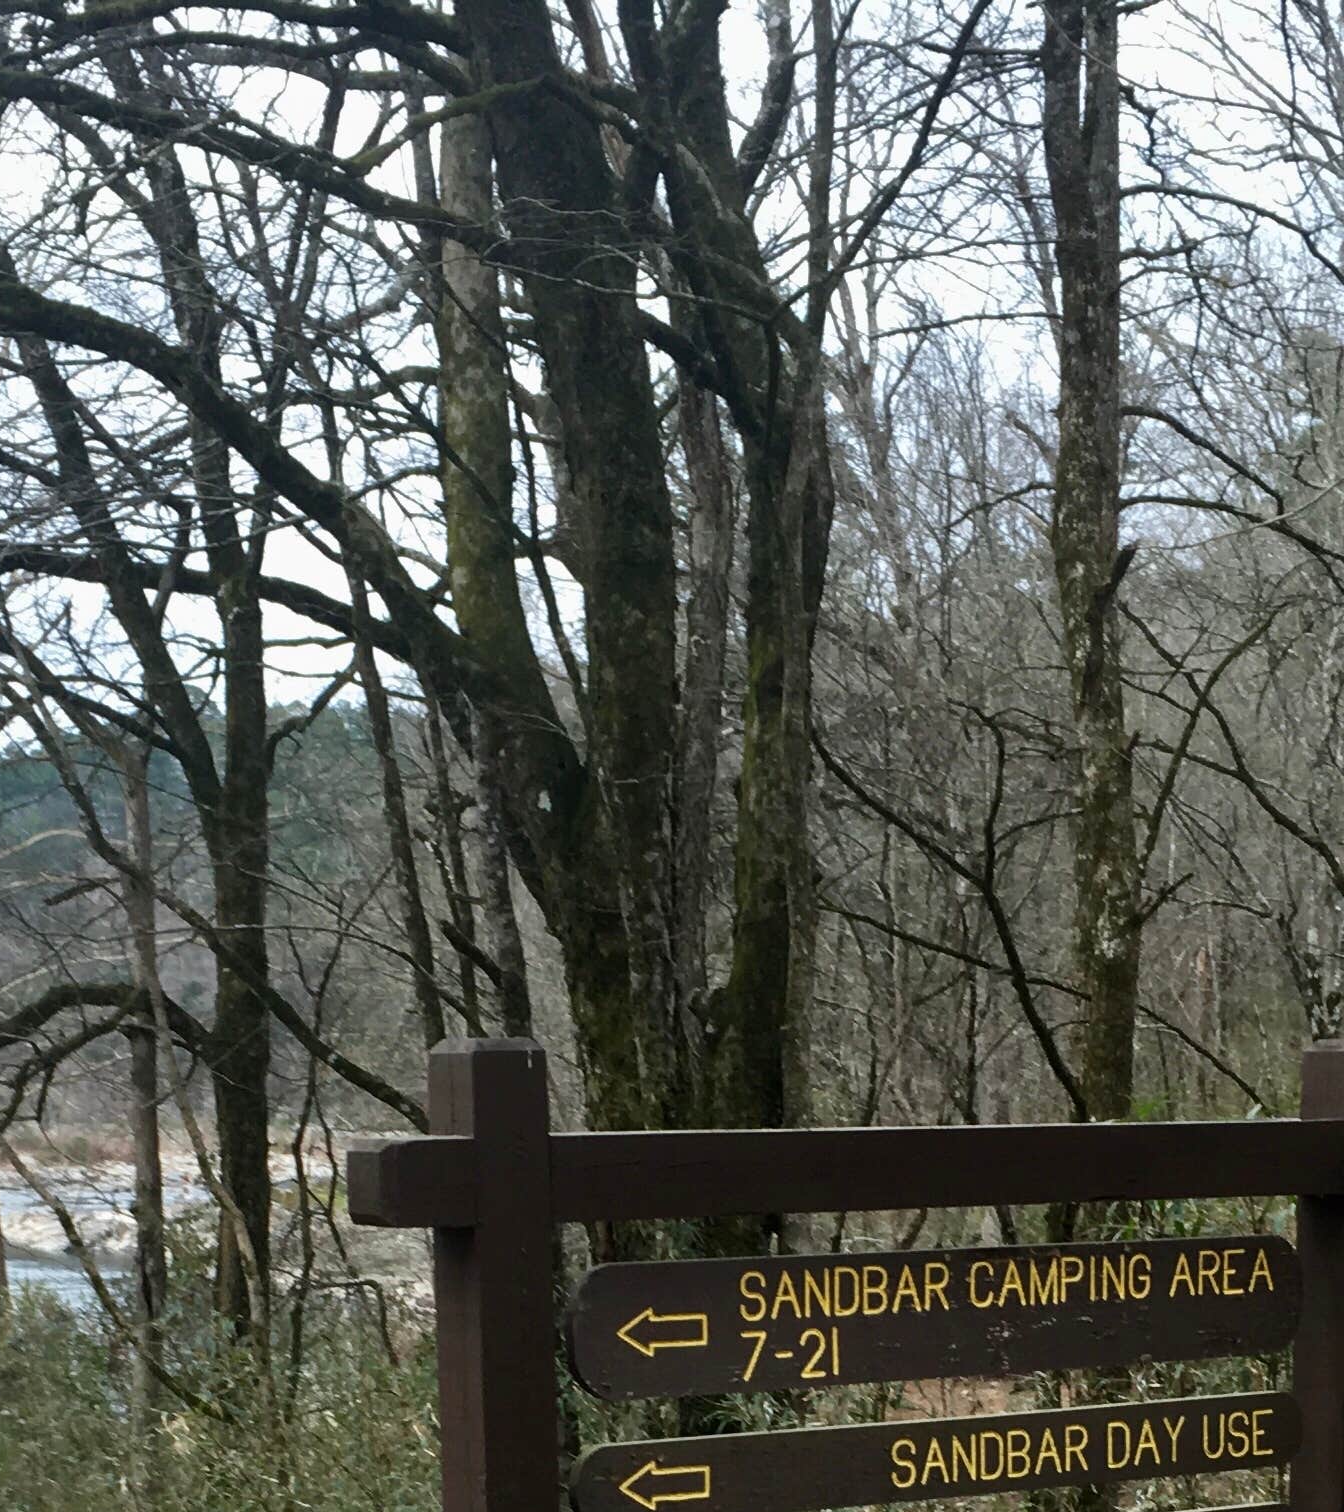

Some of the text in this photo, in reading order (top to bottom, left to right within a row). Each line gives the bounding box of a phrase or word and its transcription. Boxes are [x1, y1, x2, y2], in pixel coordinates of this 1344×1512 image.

[740, 1249, 1273, 1321] SANDBAR CAMPING AREA
[741, 1327, 839, 1382] 7-21
[891, 1409, 1273, 1488] SANDBAR DAY USE
